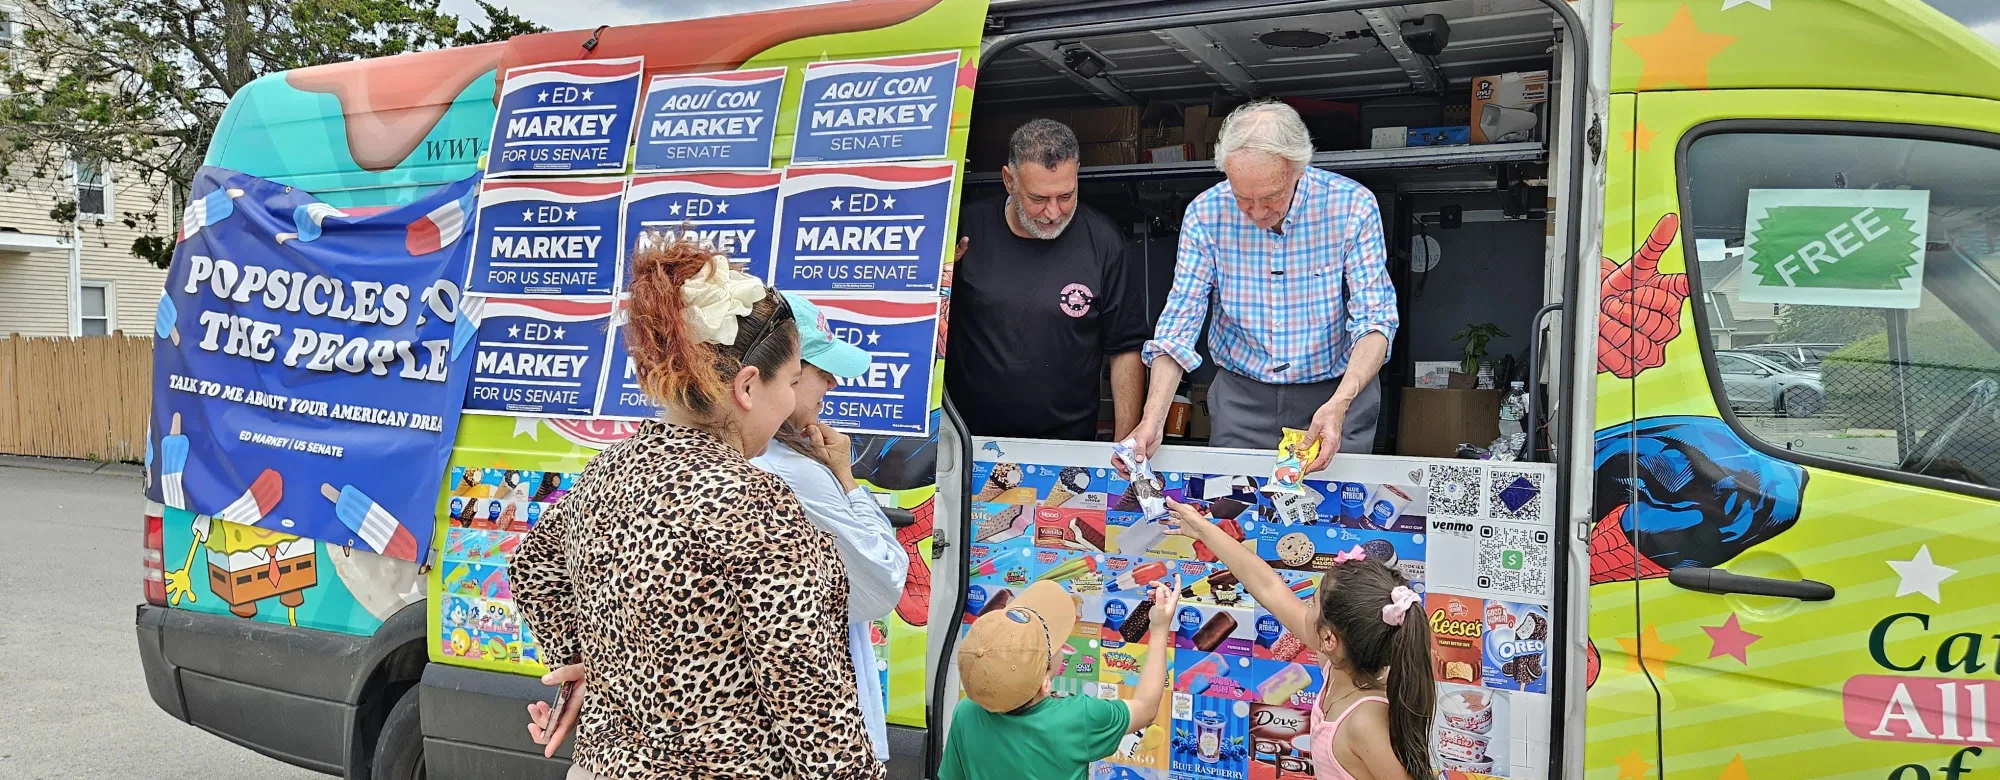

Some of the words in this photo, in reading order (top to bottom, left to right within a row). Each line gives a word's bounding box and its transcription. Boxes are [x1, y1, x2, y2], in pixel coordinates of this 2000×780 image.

[552, 87, 579, 104] ED
[821, 77, 880, 100] AQUÍ
[878, 76, 932, 97] CON
[660, 90, 716, 111] AQUÍ
[716, 91, 761, 109] CON
[811, 103, 937, 128] MARKEY
[506, 114, 617, 139] MARKEY
[650, 116, 764, 138] MARKEY
[830, 135, 903, 150] SENATE
[502, 150, 526, 163] FOR
[530, 149, 549, 161] US
[552, 147, 607, 161] SENATE
[666, 145, 731, 159] SENATE
[685, 199, 713, 216] ED
[849, 193, 878, 212] ED
[538, 206, 563, 224] ED
[795, 225, 925, 251] MARKEY
[1774, 206, 1890, 288] FREE
[490, 236, 603, 259] MARKEY
[488, 271, 516, 284] FOR
[520, 271, 539, 284] US
[542, 271, 597, 285] SENATE
[793, 266, 823, 279] FOR
[828, 265, 848, 279] US
[853, 265, 917, 280] SENATE
[184, 255, 409, 326] POPSICLES
[524, 324, 551, 341] ED
[834, 328, 863, 346] ED
[200, 310, 281, 362] THE
[283, 328, 449, 382] PEOPLE
[475, 351, 588, 378] MARKEY
[169, 374, 197, 393] TALK
[199, 380, 221, 397] TO
[221, 386, 244, 402] ME
[245, 390, 288, 412] ABOUT
[290, 397, 328, 418] YOUR
[330, 404, 408, 427] AMERICAN
[473, 387, 500, 401] FOR
[502, 388, 522, 402] US
[525, 389, 580, 405] SENATE
[619, 393, 648, 407] FOR
[839, 403, 903, 419] SENATE
[240, 430, 253, 442] ED
[252, 432, 289, 448] MARKEY
[294, 439, 307, 451] US
[307, 441, 344, 457] SENATE
[1342, 491, 1364, 500] RIBBON
[971, 511, 992, 521] BIG
[1040, 528, 1063, 536] Vanilla
[1432, 521, 1473, 532] venmo
[1500, 640, 1544, 658] OREO
[1868, 612, 2000, 675] Ca
[1106, 652, 1135, 663] SOUR
[1254, 710, 1300, 727] Dove
[1869, 682, 1994, 742] All
[1173, 761, 1193, 772] BLUE
[1195, 764, 1243, 779] RASPBERRY
